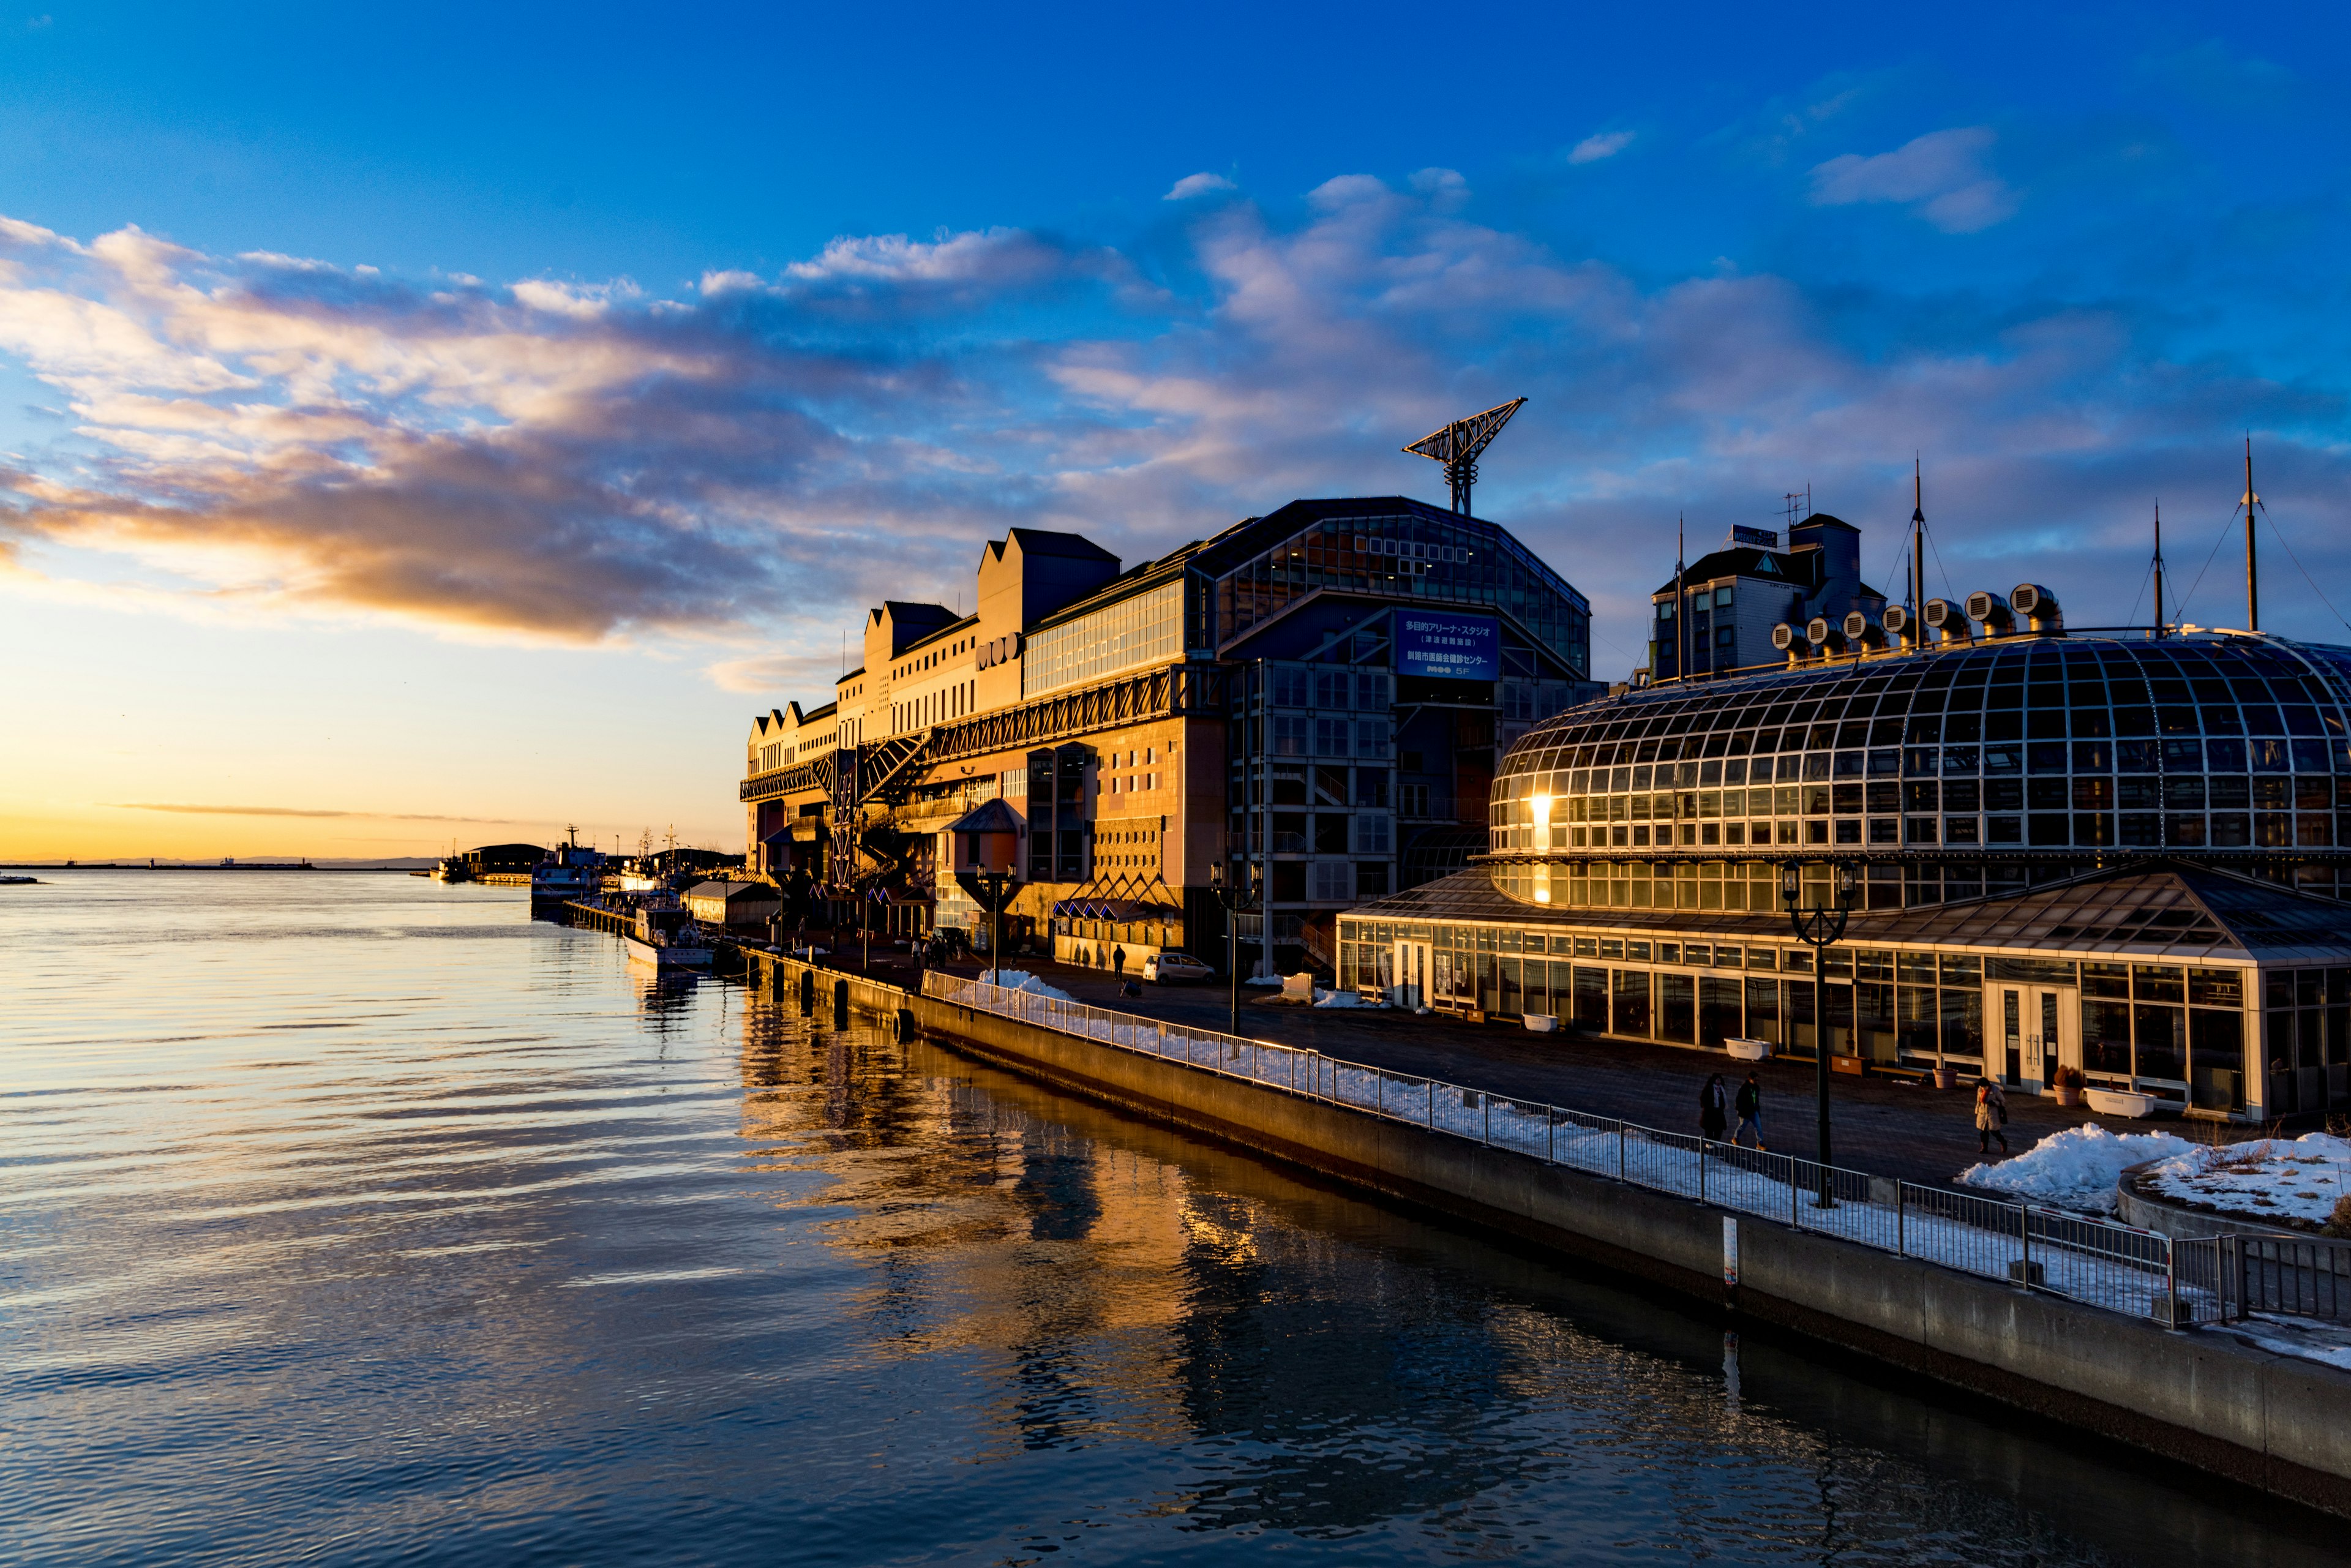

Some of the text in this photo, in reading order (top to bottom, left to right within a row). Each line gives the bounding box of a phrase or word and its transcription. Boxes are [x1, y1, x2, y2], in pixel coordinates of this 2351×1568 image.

[1406, 620, 1490, 637] 多目的アリーナ・スタジオ
[975, 632, 1018, 672] MOO
[1407, 650, 1488, 665] 釧路市医師会健診センター
